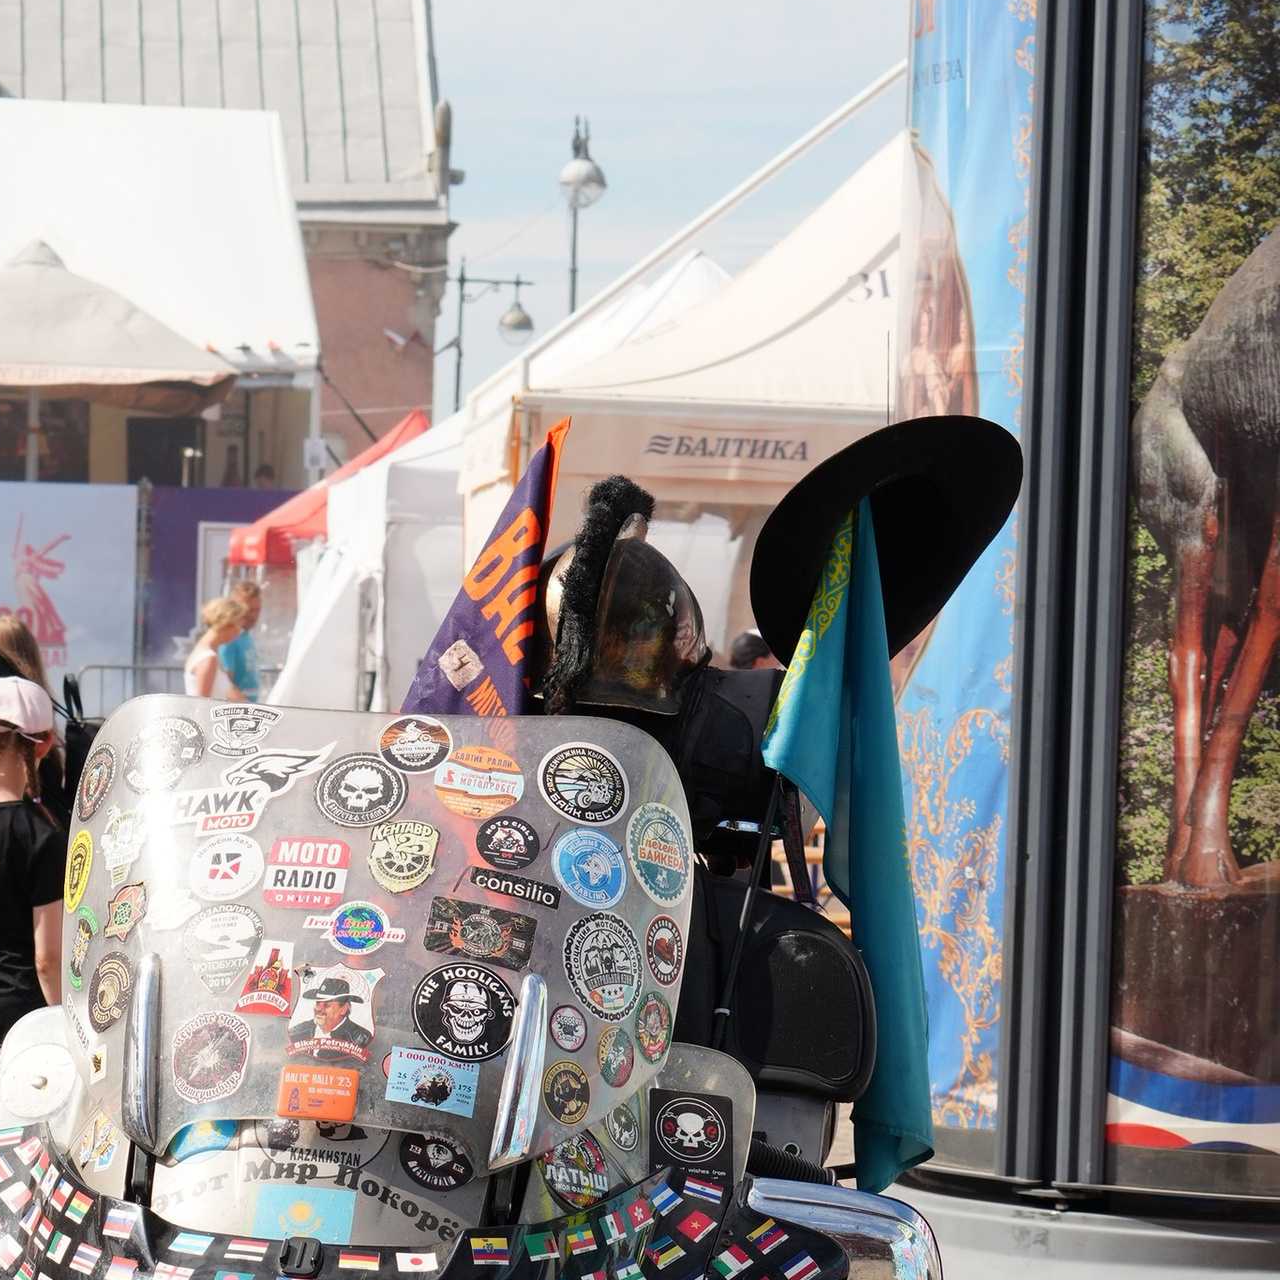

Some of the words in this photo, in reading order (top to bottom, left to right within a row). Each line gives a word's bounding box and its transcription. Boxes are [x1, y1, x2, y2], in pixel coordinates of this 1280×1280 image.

[672, 435, 809, 461] БАЛТИКА
[455, 752, 484, 764] БАЛТИК
[487, 756, 513, 769] РАЛЛИ
[547, 749, 586, 775] ЖЕМЧУЖИНА
[460, 777, 516, 794] МОТОПРОБЕГ
[175, 790, 259, 817] HAWK
[550, 793, 582, 819] БАЙК
[585, 806, 616, 821] ФЕСТ
[207, 814, 251, 830] MOTO
[371, 821, 434, 841] КЕНТАВР
[485, 821, 509, 835] MOTO
[513, 821, 534, 841] GIRLS
[233, 836, 253, 849] Авто
[644, 837, 679, 856] печень
[278, 841, 342, 865] MOTO
[639, 845, 685, 871] БАЙКЕРА
[273, 869, 337, 890] RADIO
[475, 875, 555, 905] consilio
[308, 918, 338, 927] Iron
[342, 918, 375, 928] Butt
[573, 926, 591, 981] АССОЦИАЦИЯ
[595, 921, 638, 974] МОТОЦИКЛИСТОВ
[193, 958, 249, 972] МОТОБУХТА
[208, 978, 231, 988] 2019
[419, 978, 441, 1006] THE
[443, 968, 514, 1018] HOOLIGANS
[556, 1013, 583, 1026] Scooter
[294, 1040, 319, 1049] Biker
[320, 1038, 363, 1055] Petrukhin
[435, 1035, 489, 1057] FAMILY
[406, 1052, 425, 1062] 000
[427, 1055, 447, 1066] 000
[285, 1072, 310, 1083] BALTIC
[312, 1073, 335, 1085] RALLY
[397, 1072, 407, 1080] 25
[458, 1084, 472, 1093] 175
[290, 1147, 361, 1166] KAZAKHSTAN
[244, 1161, 319, 1184] Мир
[545, 1164, 609, 1192] ЛАТЫШ
